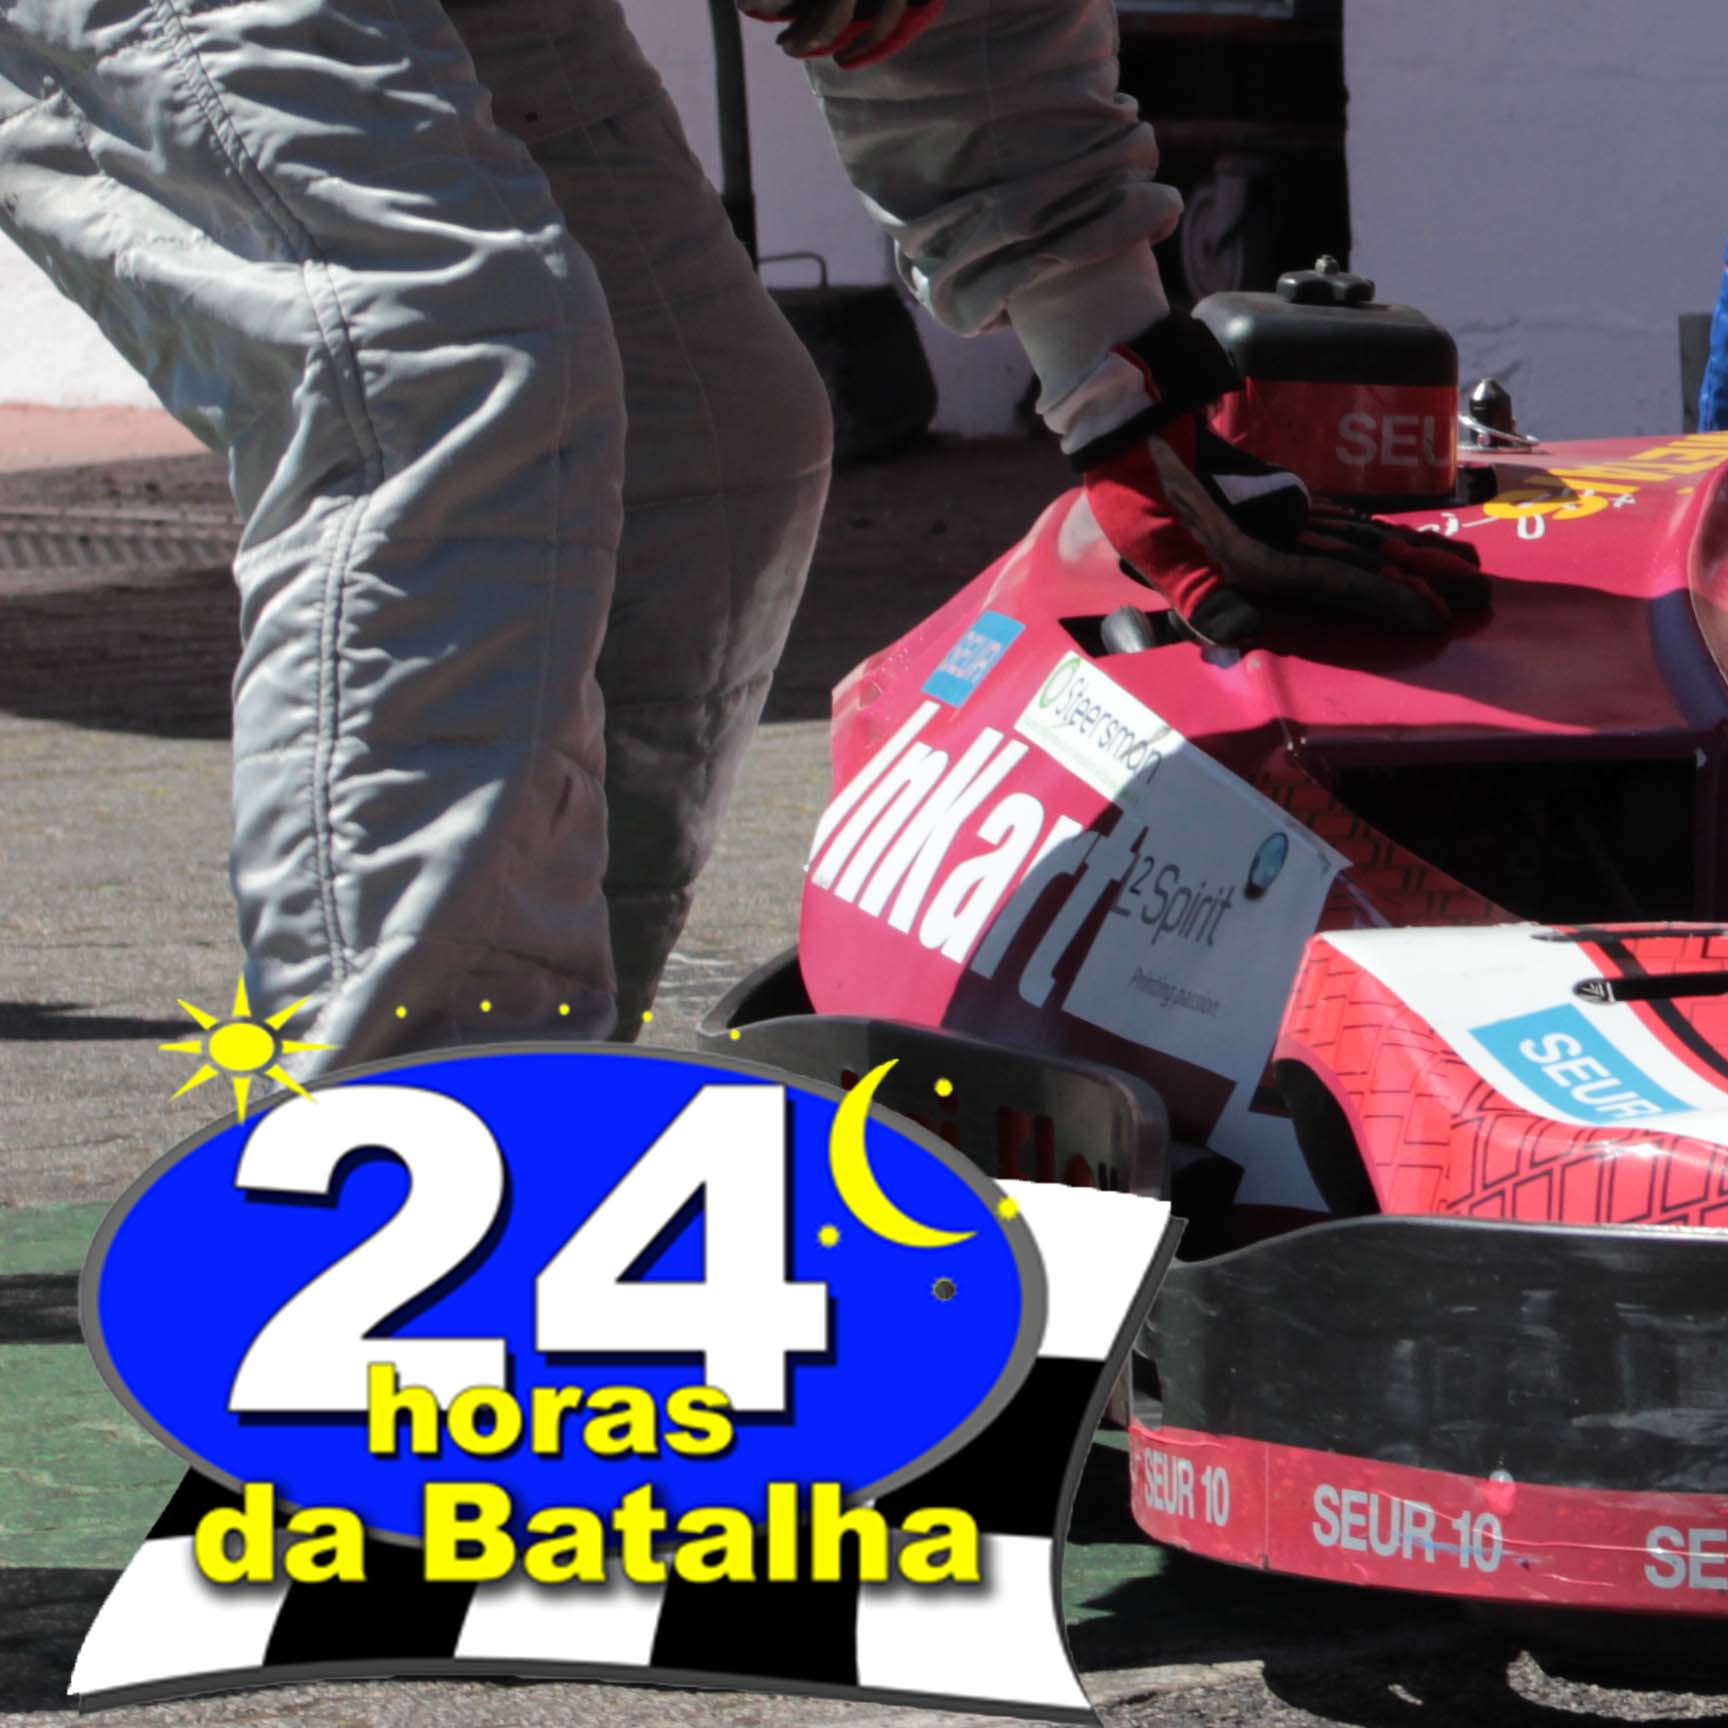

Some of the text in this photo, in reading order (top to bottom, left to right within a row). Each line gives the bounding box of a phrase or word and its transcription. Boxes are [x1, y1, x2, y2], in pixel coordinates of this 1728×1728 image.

[1518, 1031, 1665, 1120] SEUR
[1143, 1447, 1230, 1527] SEUR 10
[1311, 1482, 1504, 1573] SEUR 10
